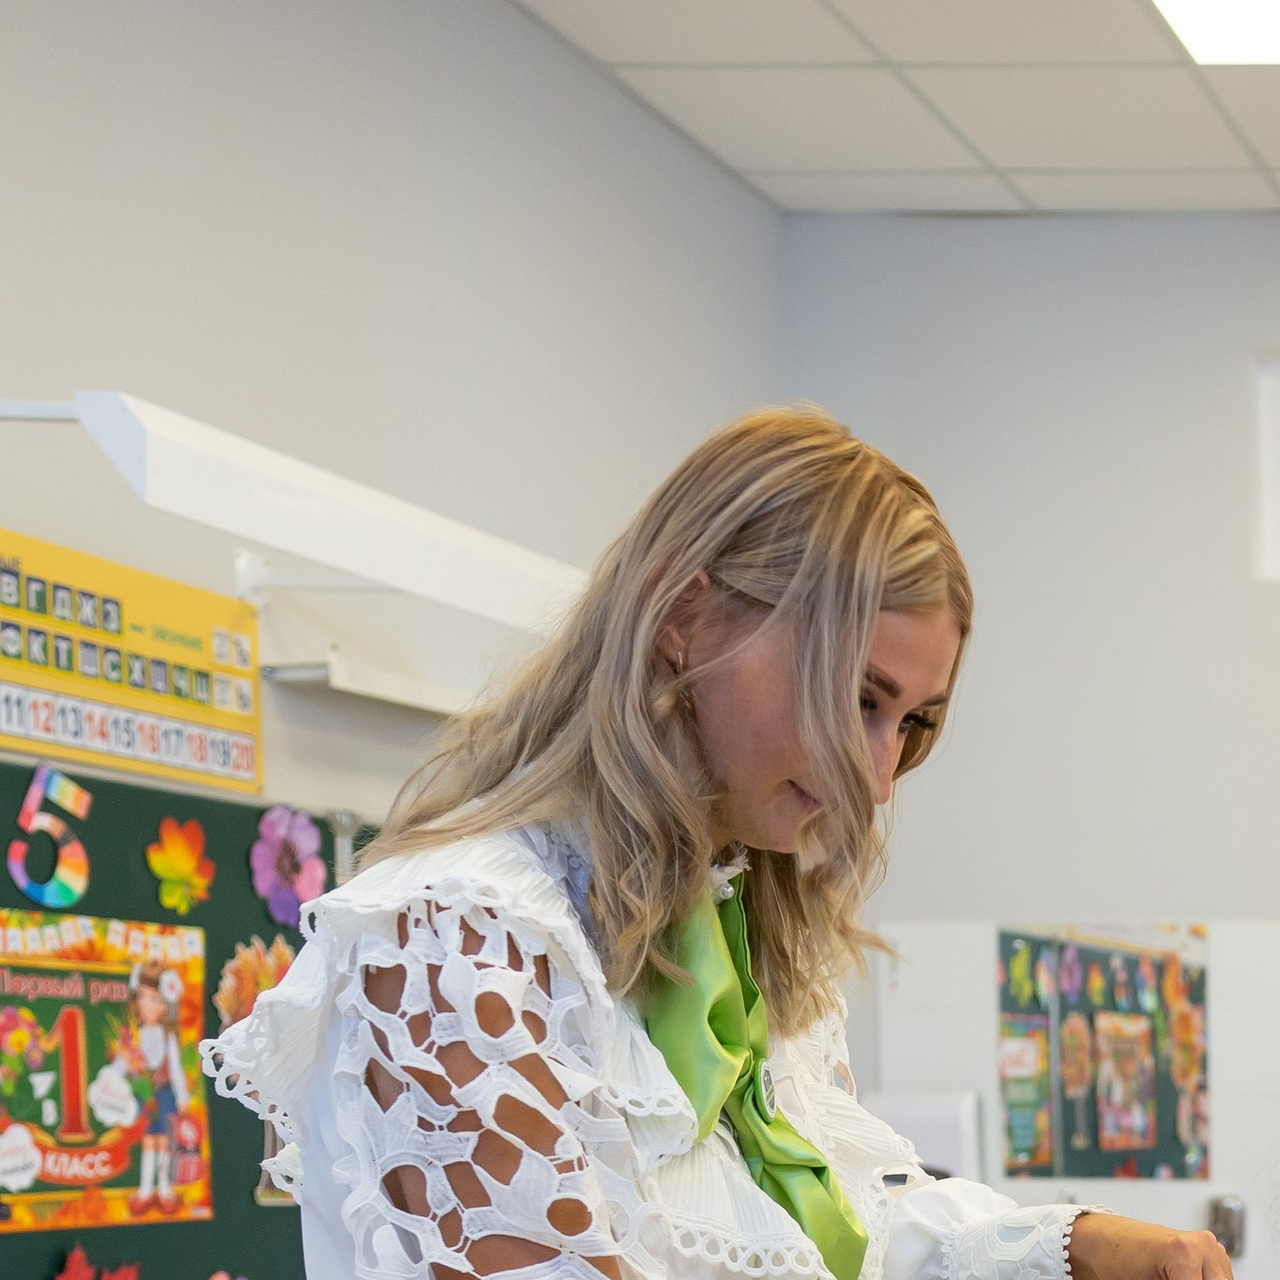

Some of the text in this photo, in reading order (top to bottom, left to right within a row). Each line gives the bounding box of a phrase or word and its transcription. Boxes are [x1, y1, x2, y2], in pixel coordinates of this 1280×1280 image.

[27, 580, 45, 611] Г
[53, 587, 73, 621] Д
[77, 592, 97, 628] Ж
[28, 630, 47, 665] К
[55, 636, 73, 672] Т
[104, 650, 121, 684] С
[3, 692, 24, 726] 11
[30, 698, 55, 735] 12
[57, 704, 83, 740] 13
[85, 709, 109, 742] 14
[111, 716, 136, 749] 15
[161, 726, 184, 758] 17
[209, 736, 231, 769] 19
[231, 740, 254, 773] 20
[6, 763, 94, 908] 5
[43, 1150, 112, 1179] КЛАСС
